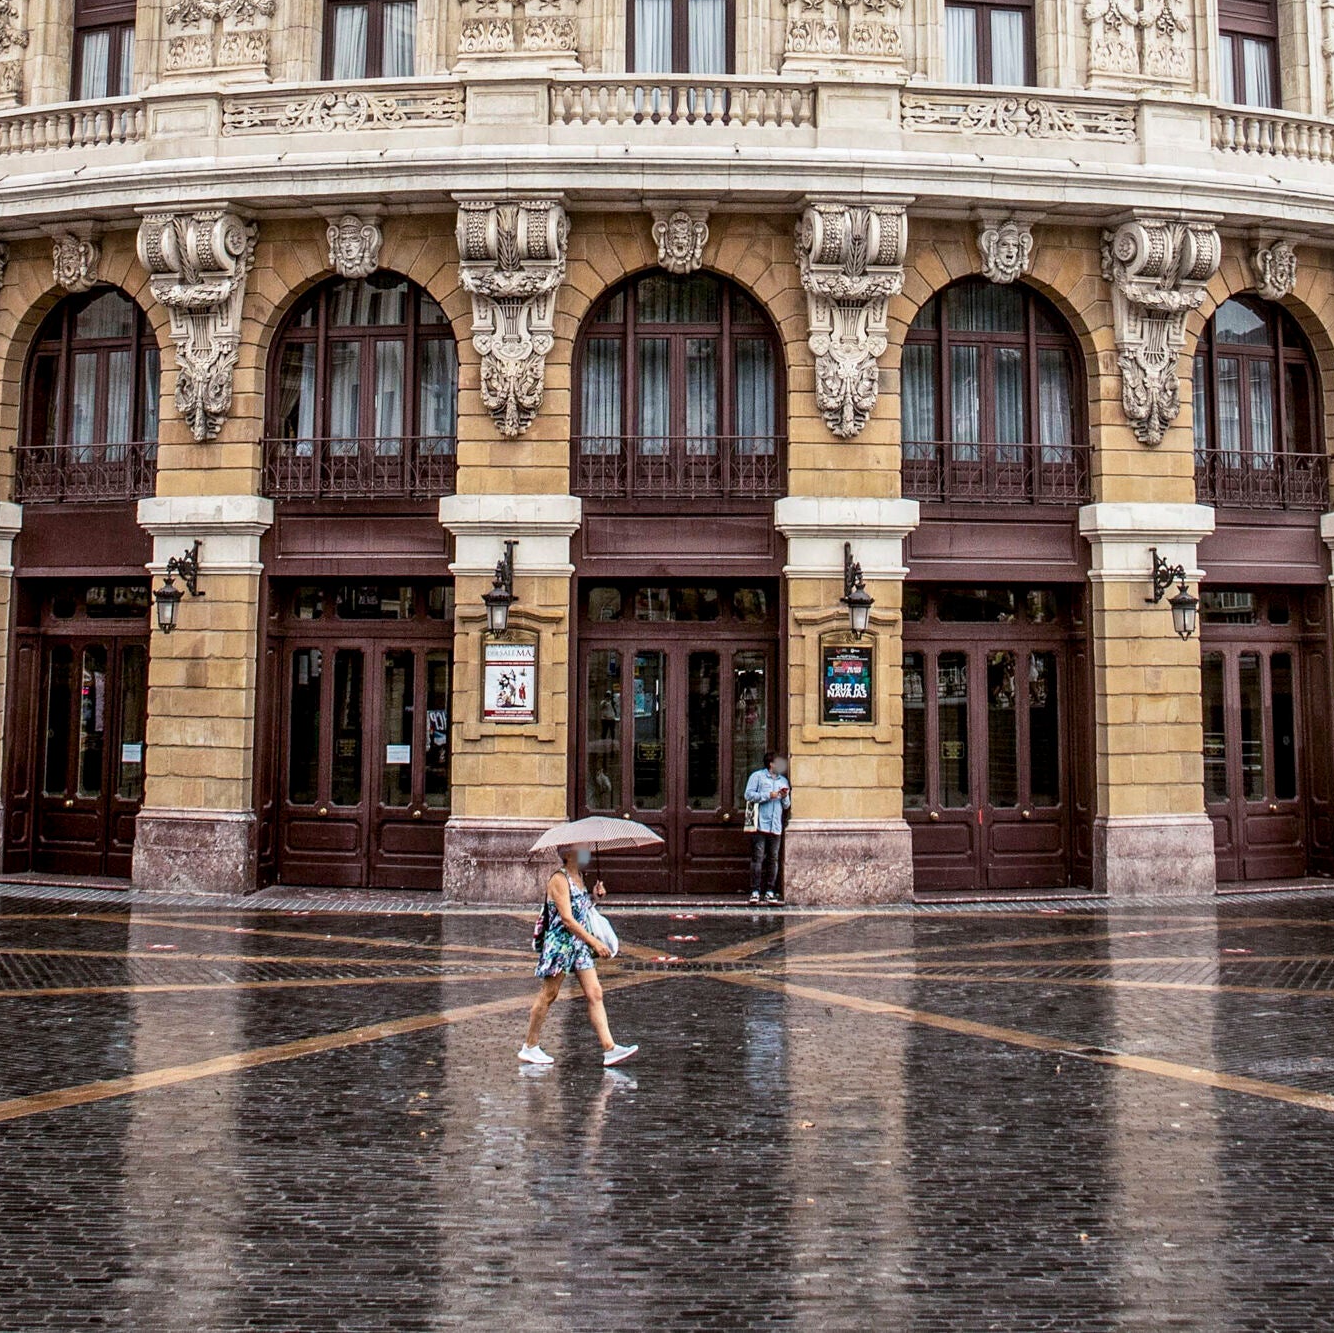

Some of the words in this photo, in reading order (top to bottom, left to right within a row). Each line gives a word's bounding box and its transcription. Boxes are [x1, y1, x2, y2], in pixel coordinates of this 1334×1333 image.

[829, 683, 852, 692] CRUZ
[854, 683, 866, 692] DE
[827, 689, 867, 699] NAVAJAS
